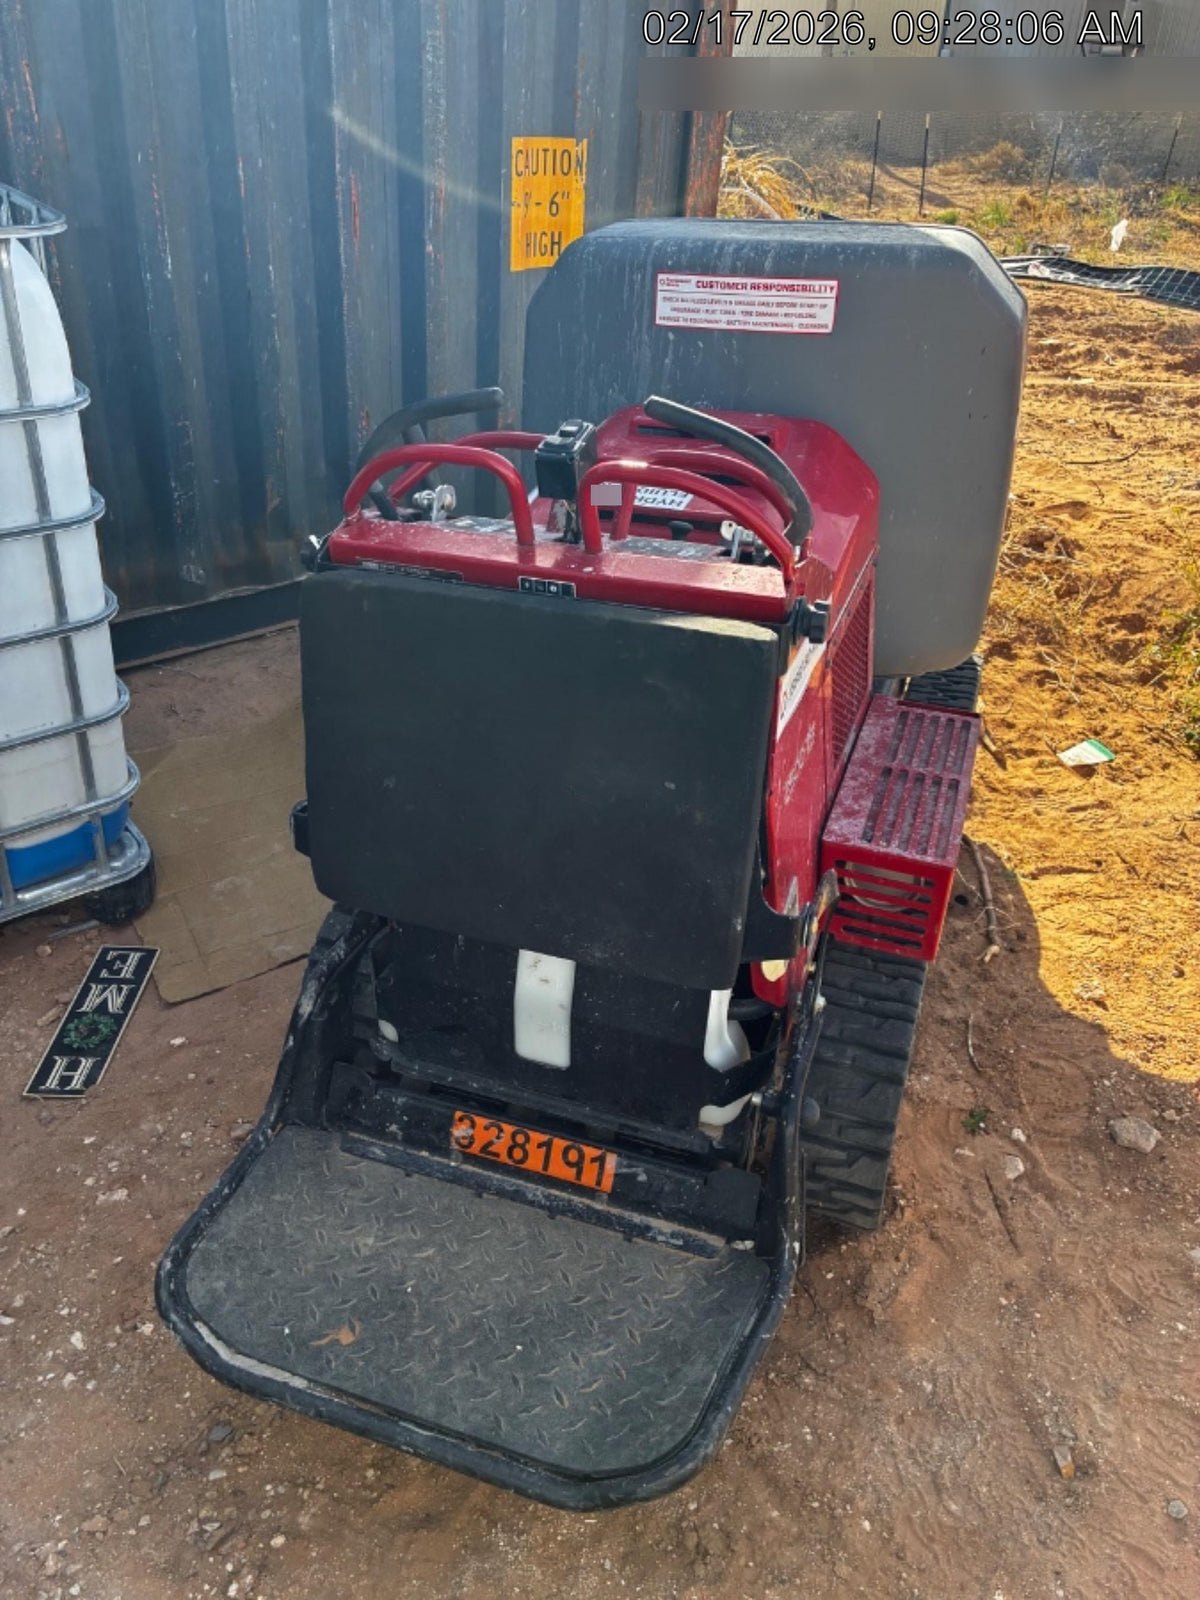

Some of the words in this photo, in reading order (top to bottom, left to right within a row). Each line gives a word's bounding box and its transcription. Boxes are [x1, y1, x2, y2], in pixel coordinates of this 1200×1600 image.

[515, 147, 584, 177] CAUTION
[525, 231, 562, 258] HIGH
[695, 280, 748, 291] CUSTOMER
[750, 281, 835, 294] RESPONSIBILITY
